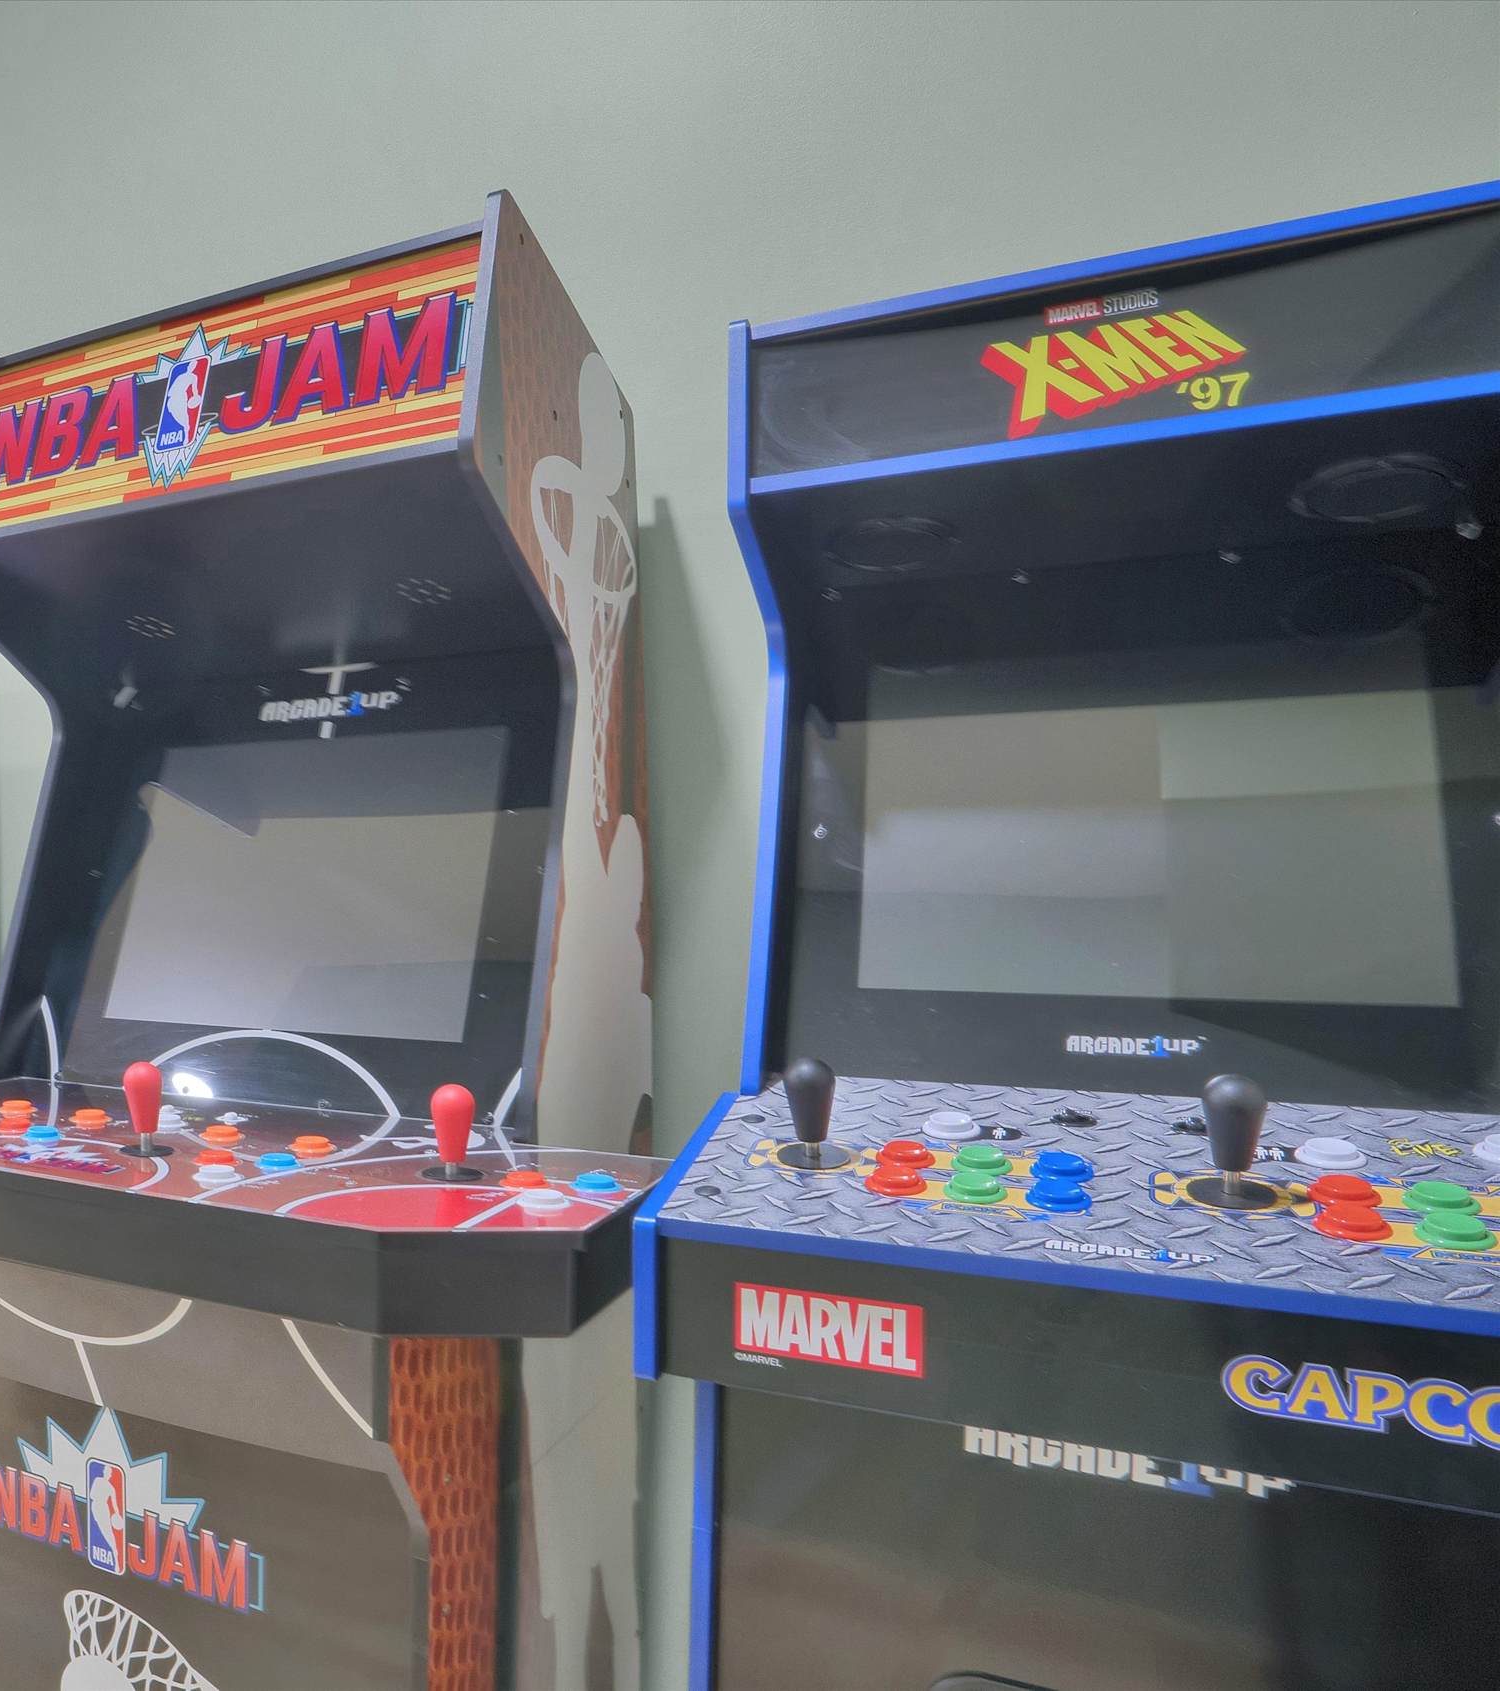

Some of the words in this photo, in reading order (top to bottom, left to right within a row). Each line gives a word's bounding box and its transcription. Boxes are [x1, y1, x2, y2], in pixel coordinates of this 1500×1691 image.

[1048, 301, 1100, 324] MARVEL
[1103, 290, 1159, 314] STUDIOS
[219, 291, 457, 434] JAM
[981, 310, 1247, 438] X-MEN
[1175, 371, 1250, 411] '97
[160, 430, 184, 446] NBA
[740, 1288, 917, 1371] MARVEL
[92, 1545, 114, 1566] NBA
[127, 1508, 251, 1615] JAM
